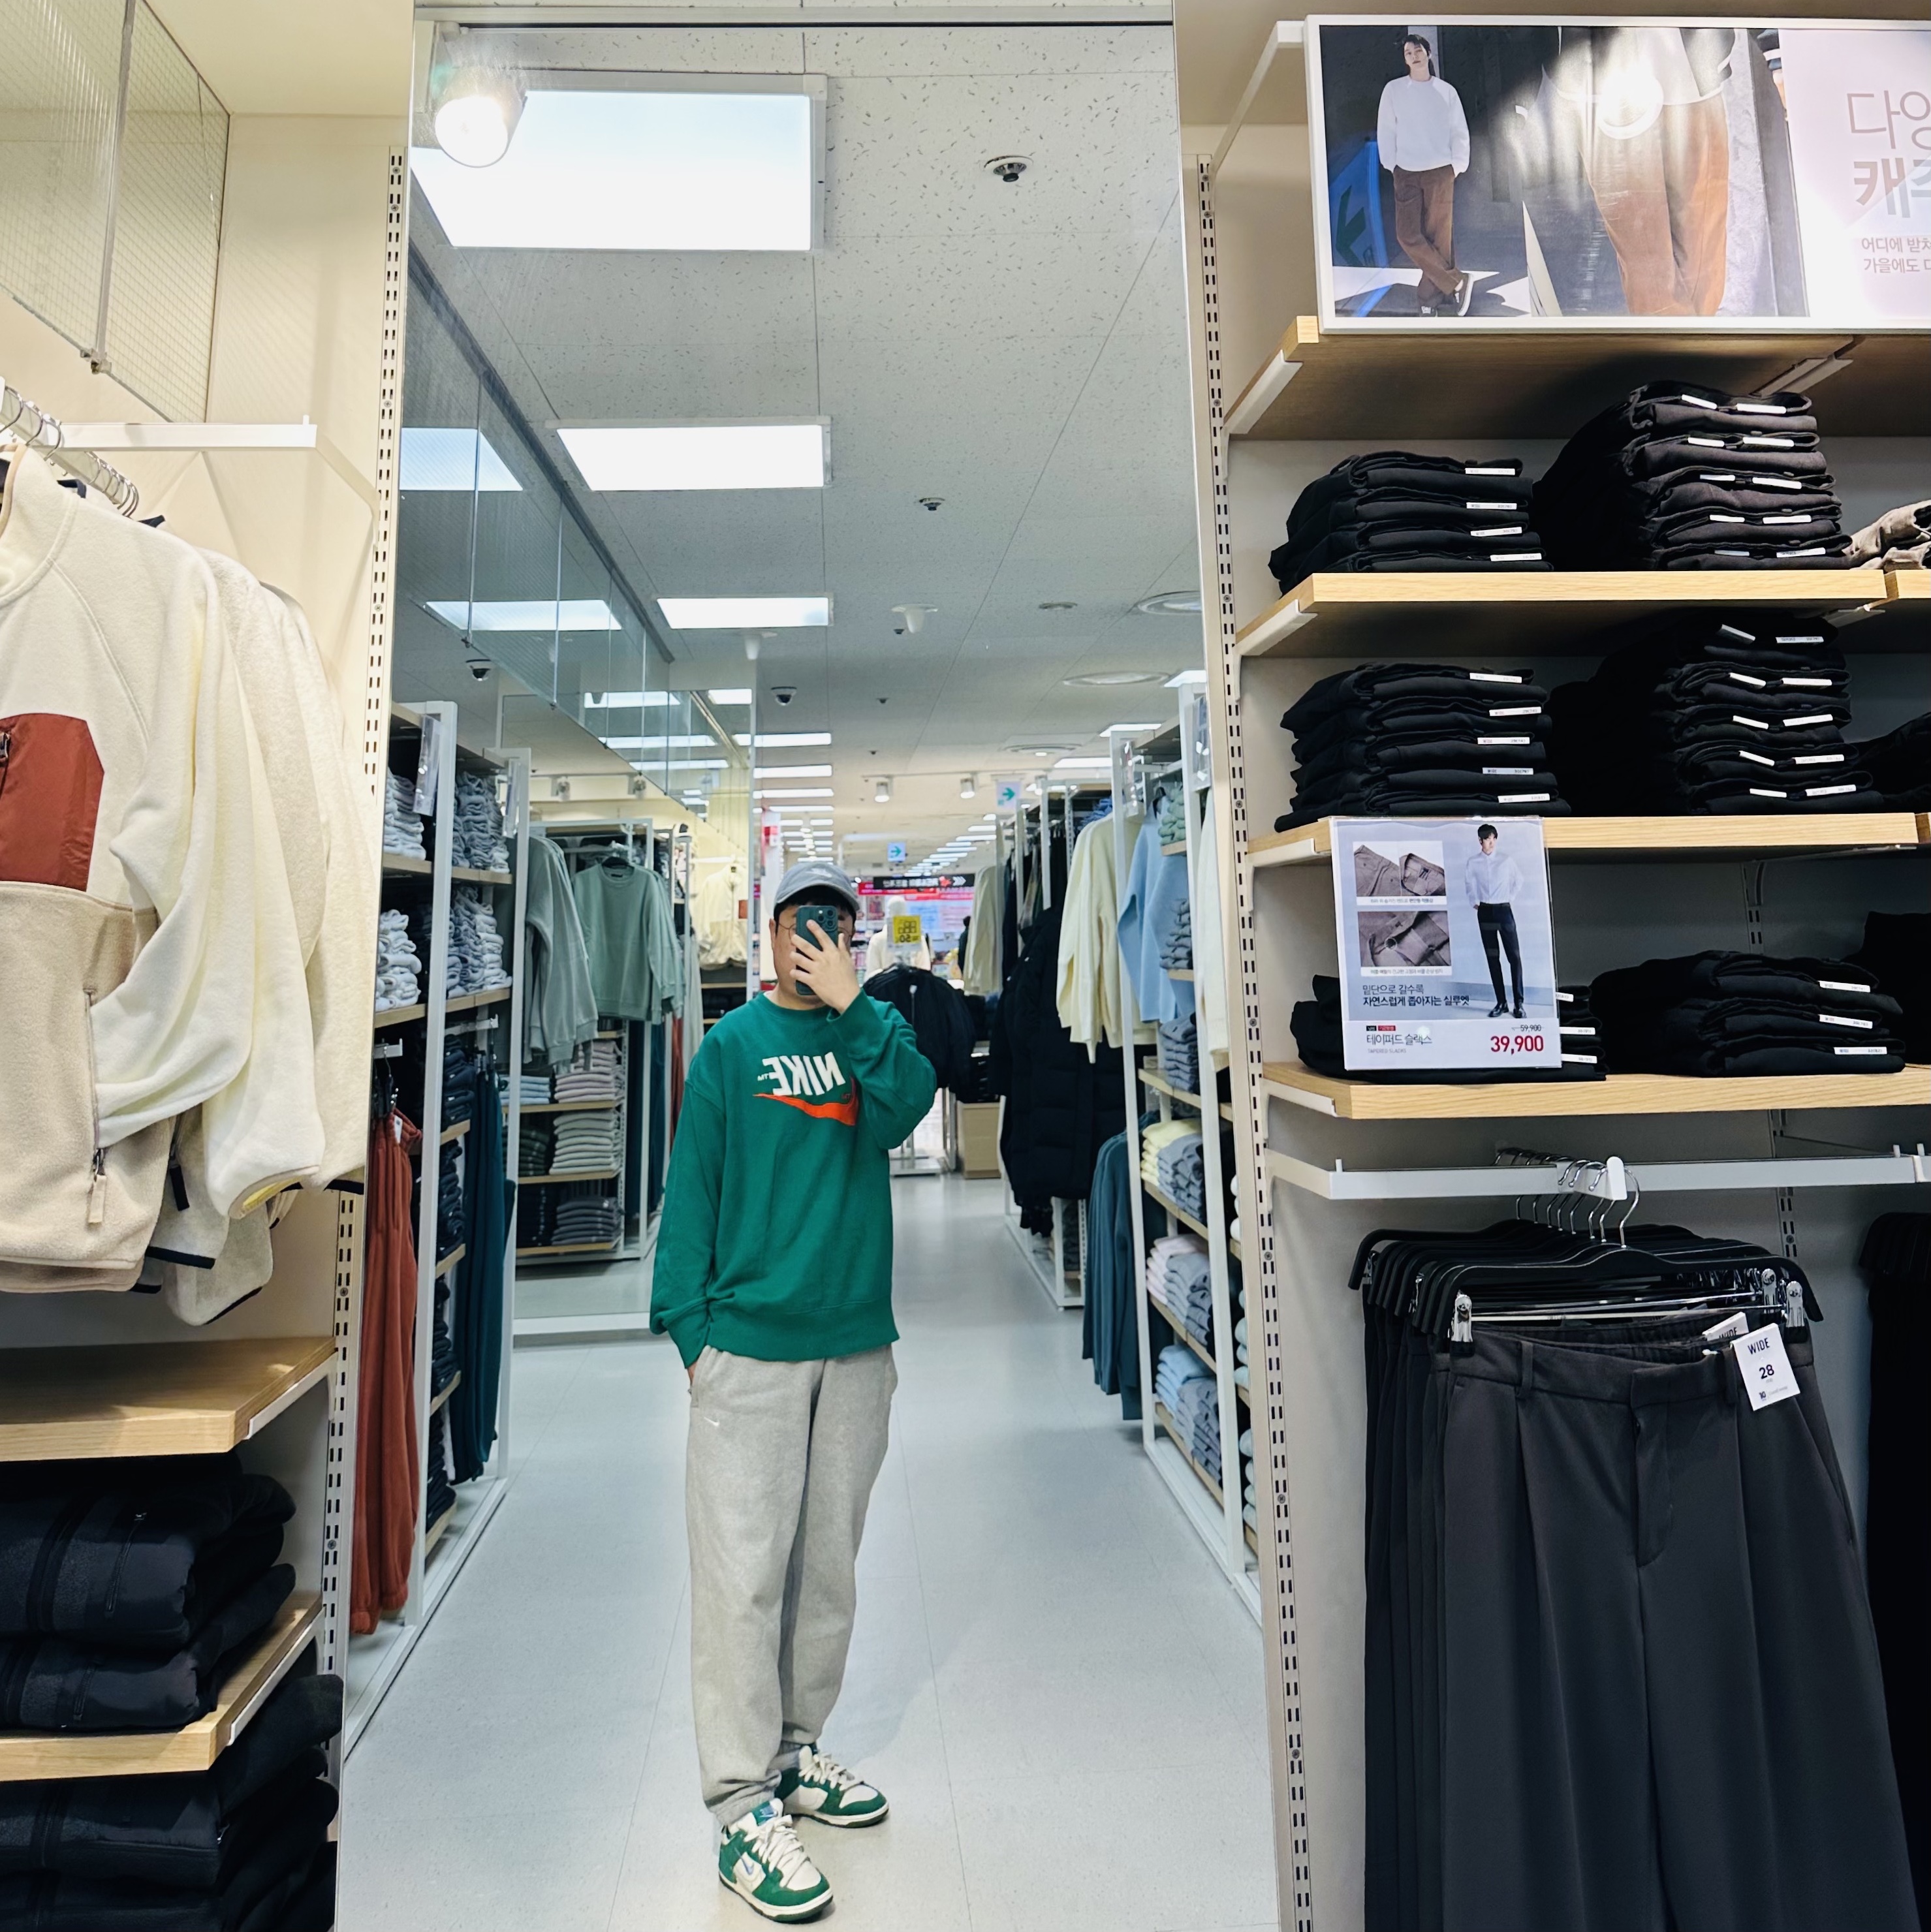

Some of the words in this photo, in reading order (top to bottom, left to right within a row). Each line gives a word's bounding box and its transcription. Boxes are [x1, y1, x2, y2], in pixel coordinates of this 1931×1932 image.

[1861, 238, 1903, 253] 어디에
[1864, 258, 1920, 273] 가을에도
[1362, 984, 1396, 995] 밑단으로
[1398, 984, 1424, 995] 갈수록
[1363, 996, 1405, 1006] 자연스럽게
[1408, 996, 1441, 1006] 좁아지는
[1443, 995, 1469, 1006] 실루엣
[1520, 1024, 1542, 1033] 59,900
[1366, 1034, 1403, 1046] 테이퍼드
[1404, 1033, 1433, 1046] 슬랙스
[1490, 1035, 1544, 1055] 39,900
[1748, 1337, 1770, 1355] WIDE
[1759, 1364, 1775, 1380] 28
